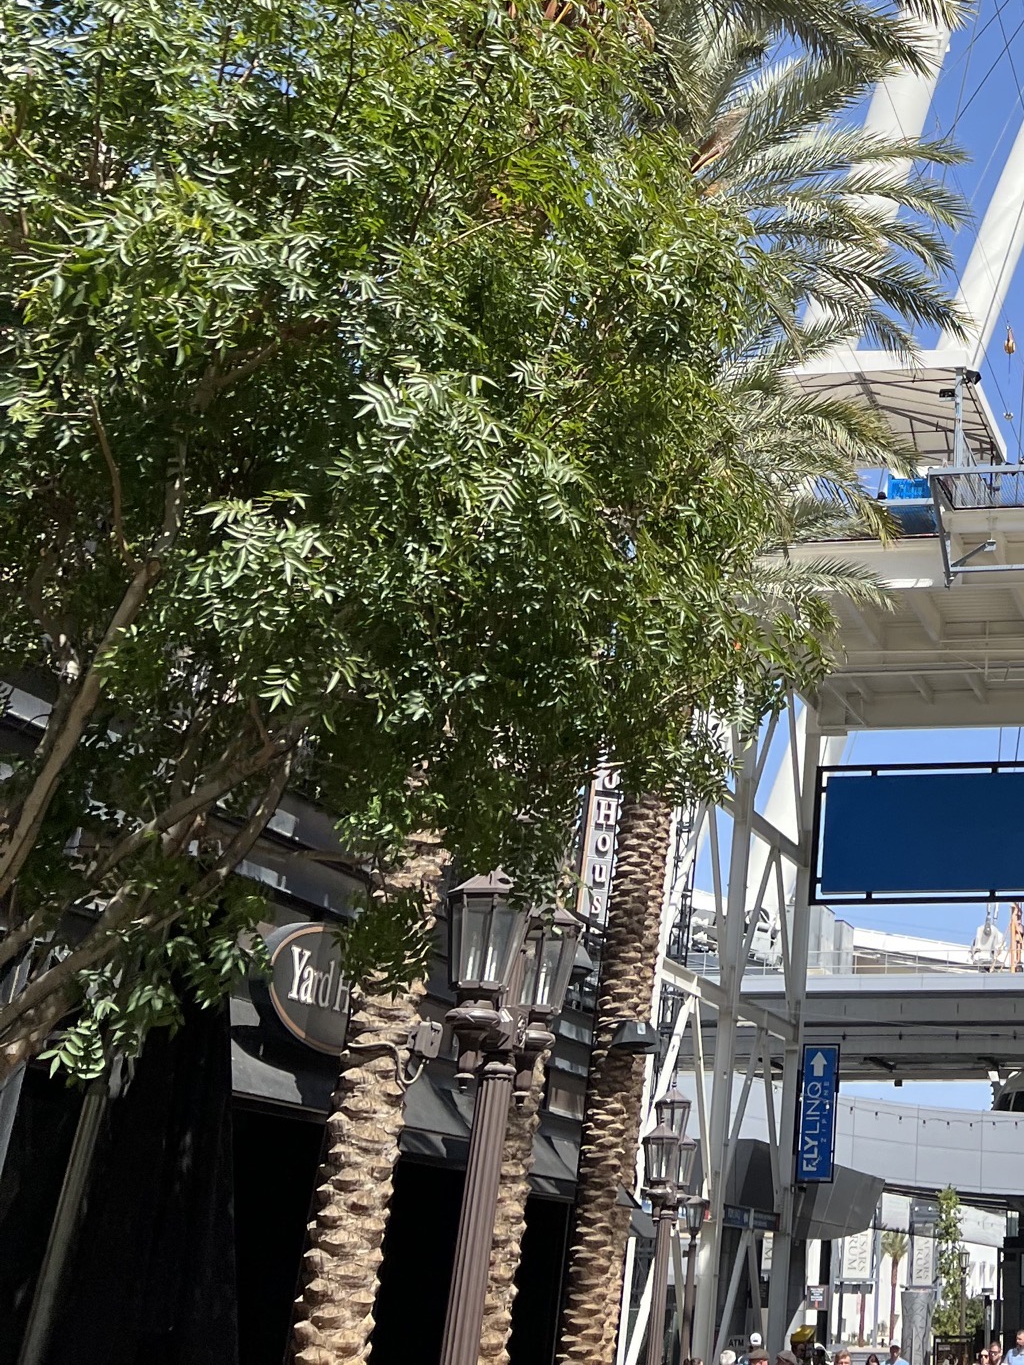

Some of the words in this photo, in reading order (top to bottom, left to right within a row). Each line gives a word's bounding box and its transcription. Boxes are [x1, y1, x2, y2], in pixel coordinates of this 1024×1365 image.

[288, 945, 335, 1008] Yard
[802, 1081, 822, 1172] FLYLINQ
[728, 1338, 744, 1347] ATM
